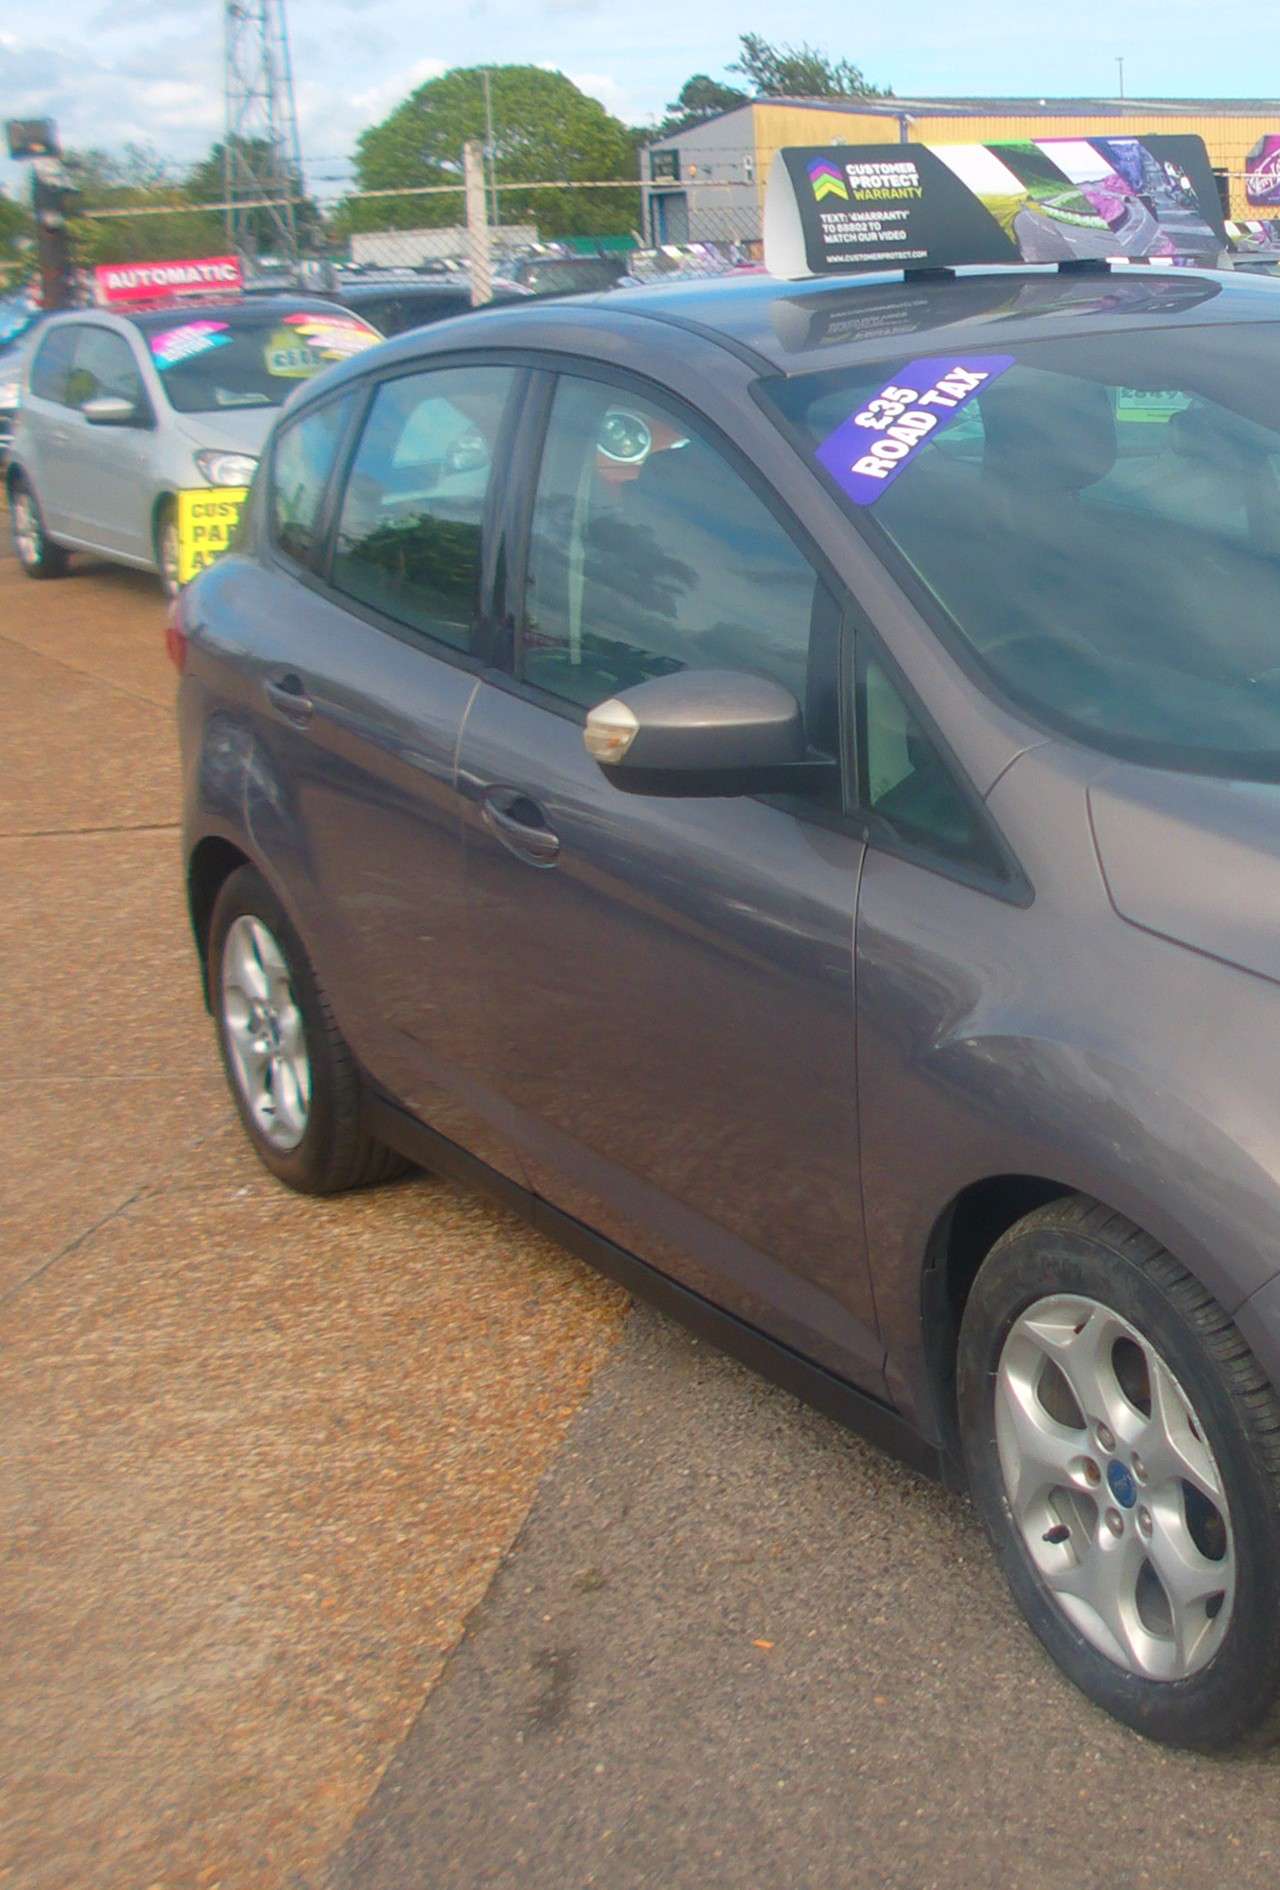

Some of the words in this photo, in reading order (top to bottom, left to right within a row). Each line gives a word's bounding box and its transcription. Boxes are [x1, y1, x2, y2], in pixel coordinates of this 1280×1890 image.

[845, 162, 917, 176] CUSTOMER
[848, 173, 920, 189] PROTECT
[852, 186, 923, 201] WARRANTY
[822, 223, 837, 234] TO
[869, 221, 882, 232] TO
[858, 231, 878, 242] OUR
[878, 229, 908, 242] VIDEO
[107, 262, 240, 290] AUTOMATIC
[854, 385, 920, 430] £35
[851, 410, 938, 479] ROAD
[918, 366, 990, 408] TAX
